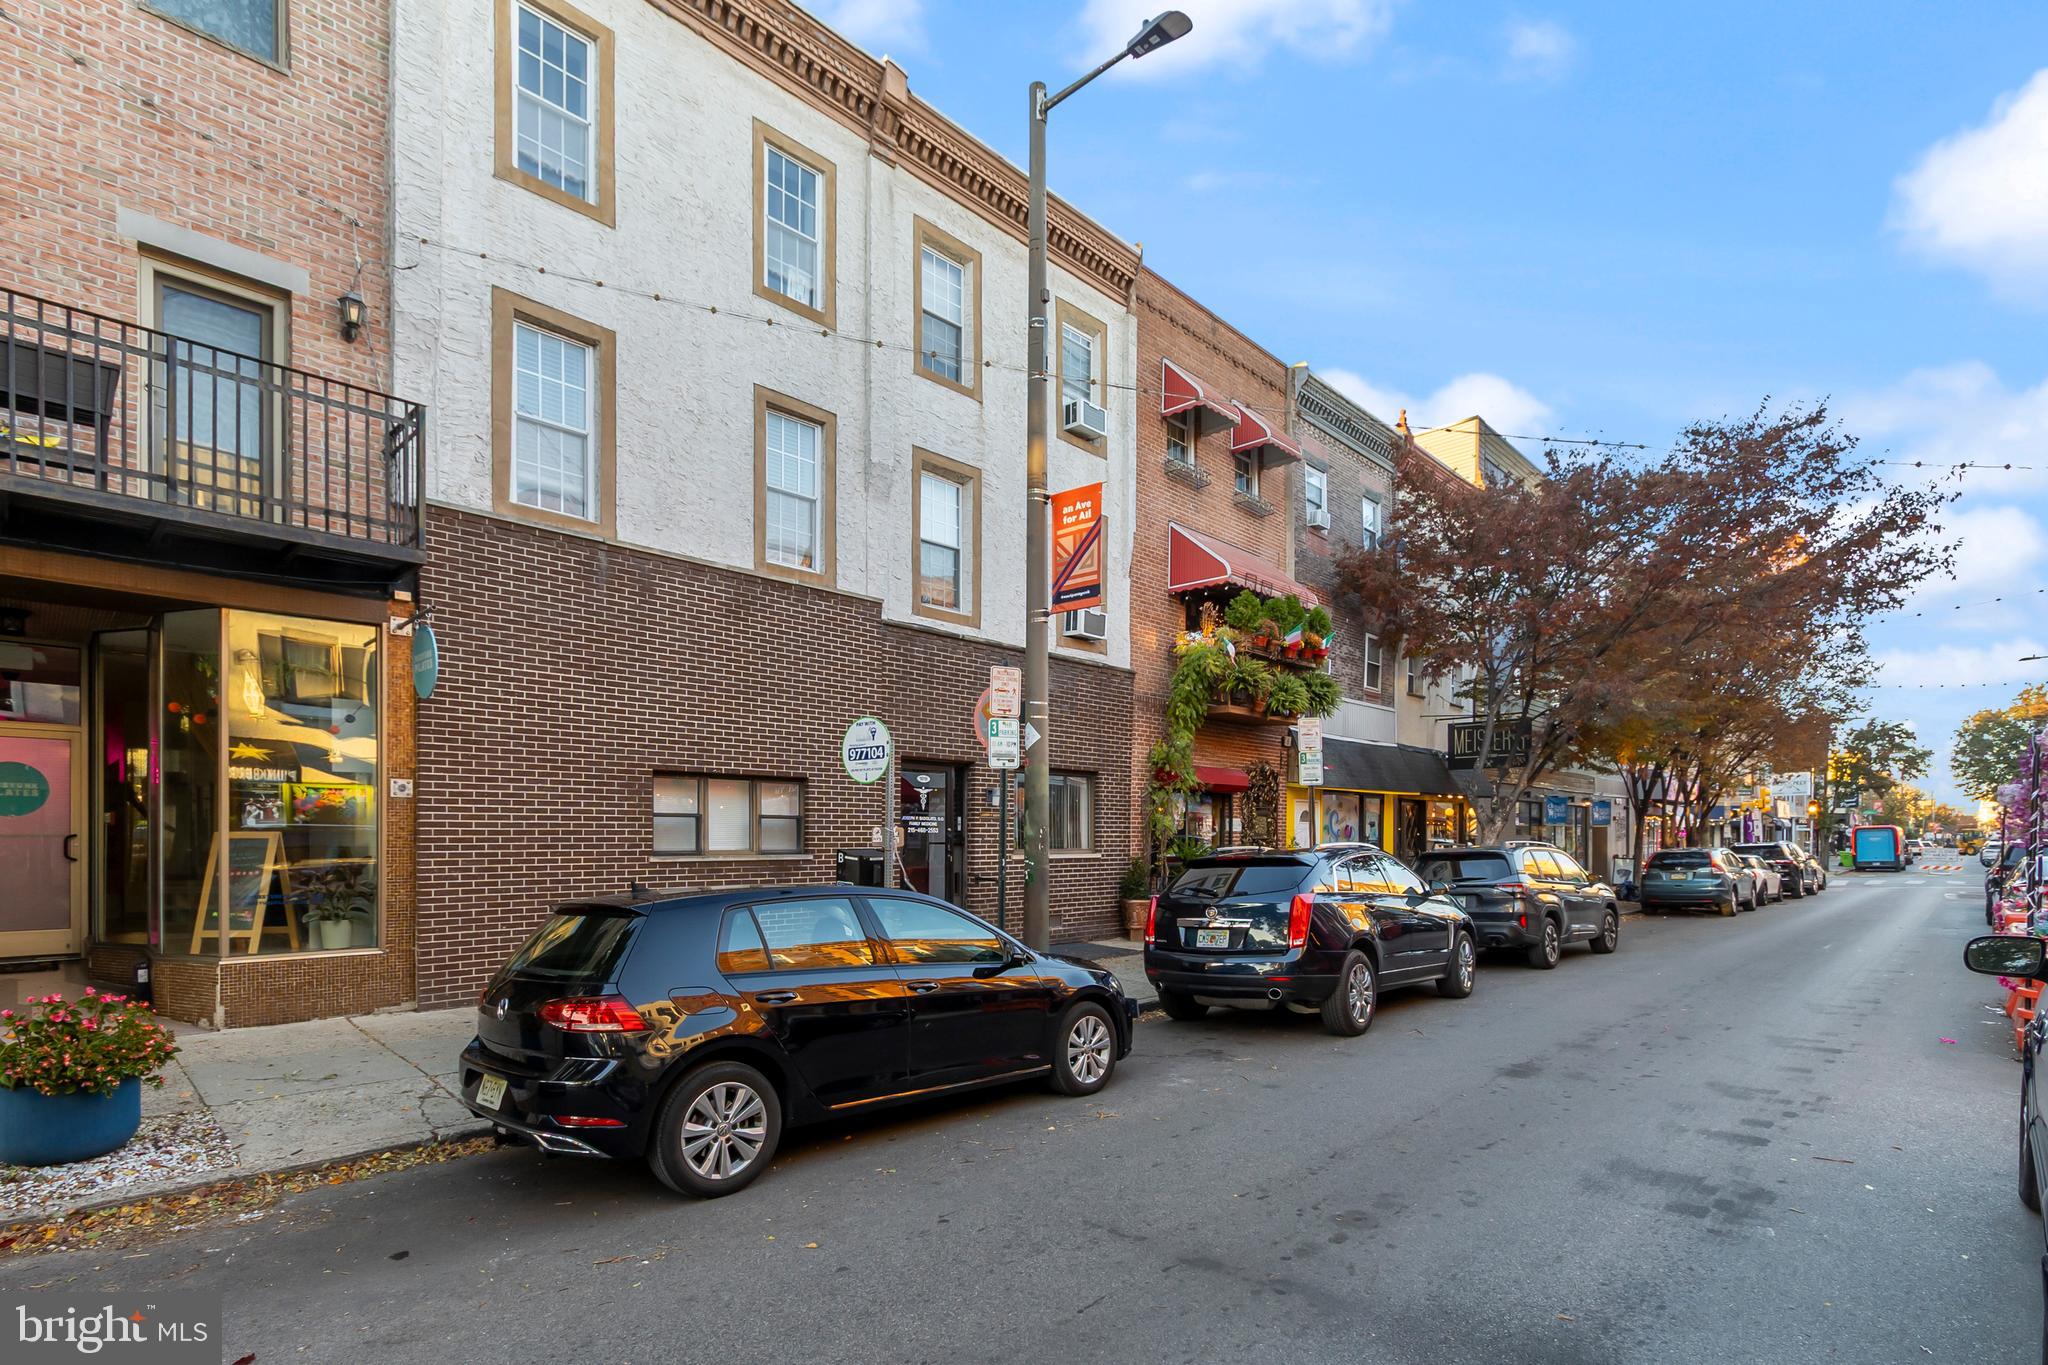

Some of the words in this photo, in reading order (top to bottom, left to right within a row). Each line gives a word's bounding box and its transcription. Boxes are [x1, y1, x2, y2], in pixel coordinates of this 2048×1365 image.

[1063, 504, 1074, 515] an
[1075, 500, 1092, 511] Ave
[1063, 513, 1077, 525] for
[1079, 509, 1092, 521] All
[991, 721, 997, 735] 3
[849, 746, 884, 760] 977104
[1301, 754, 1306, 763] 3
[838, 852, 844, 863] B
